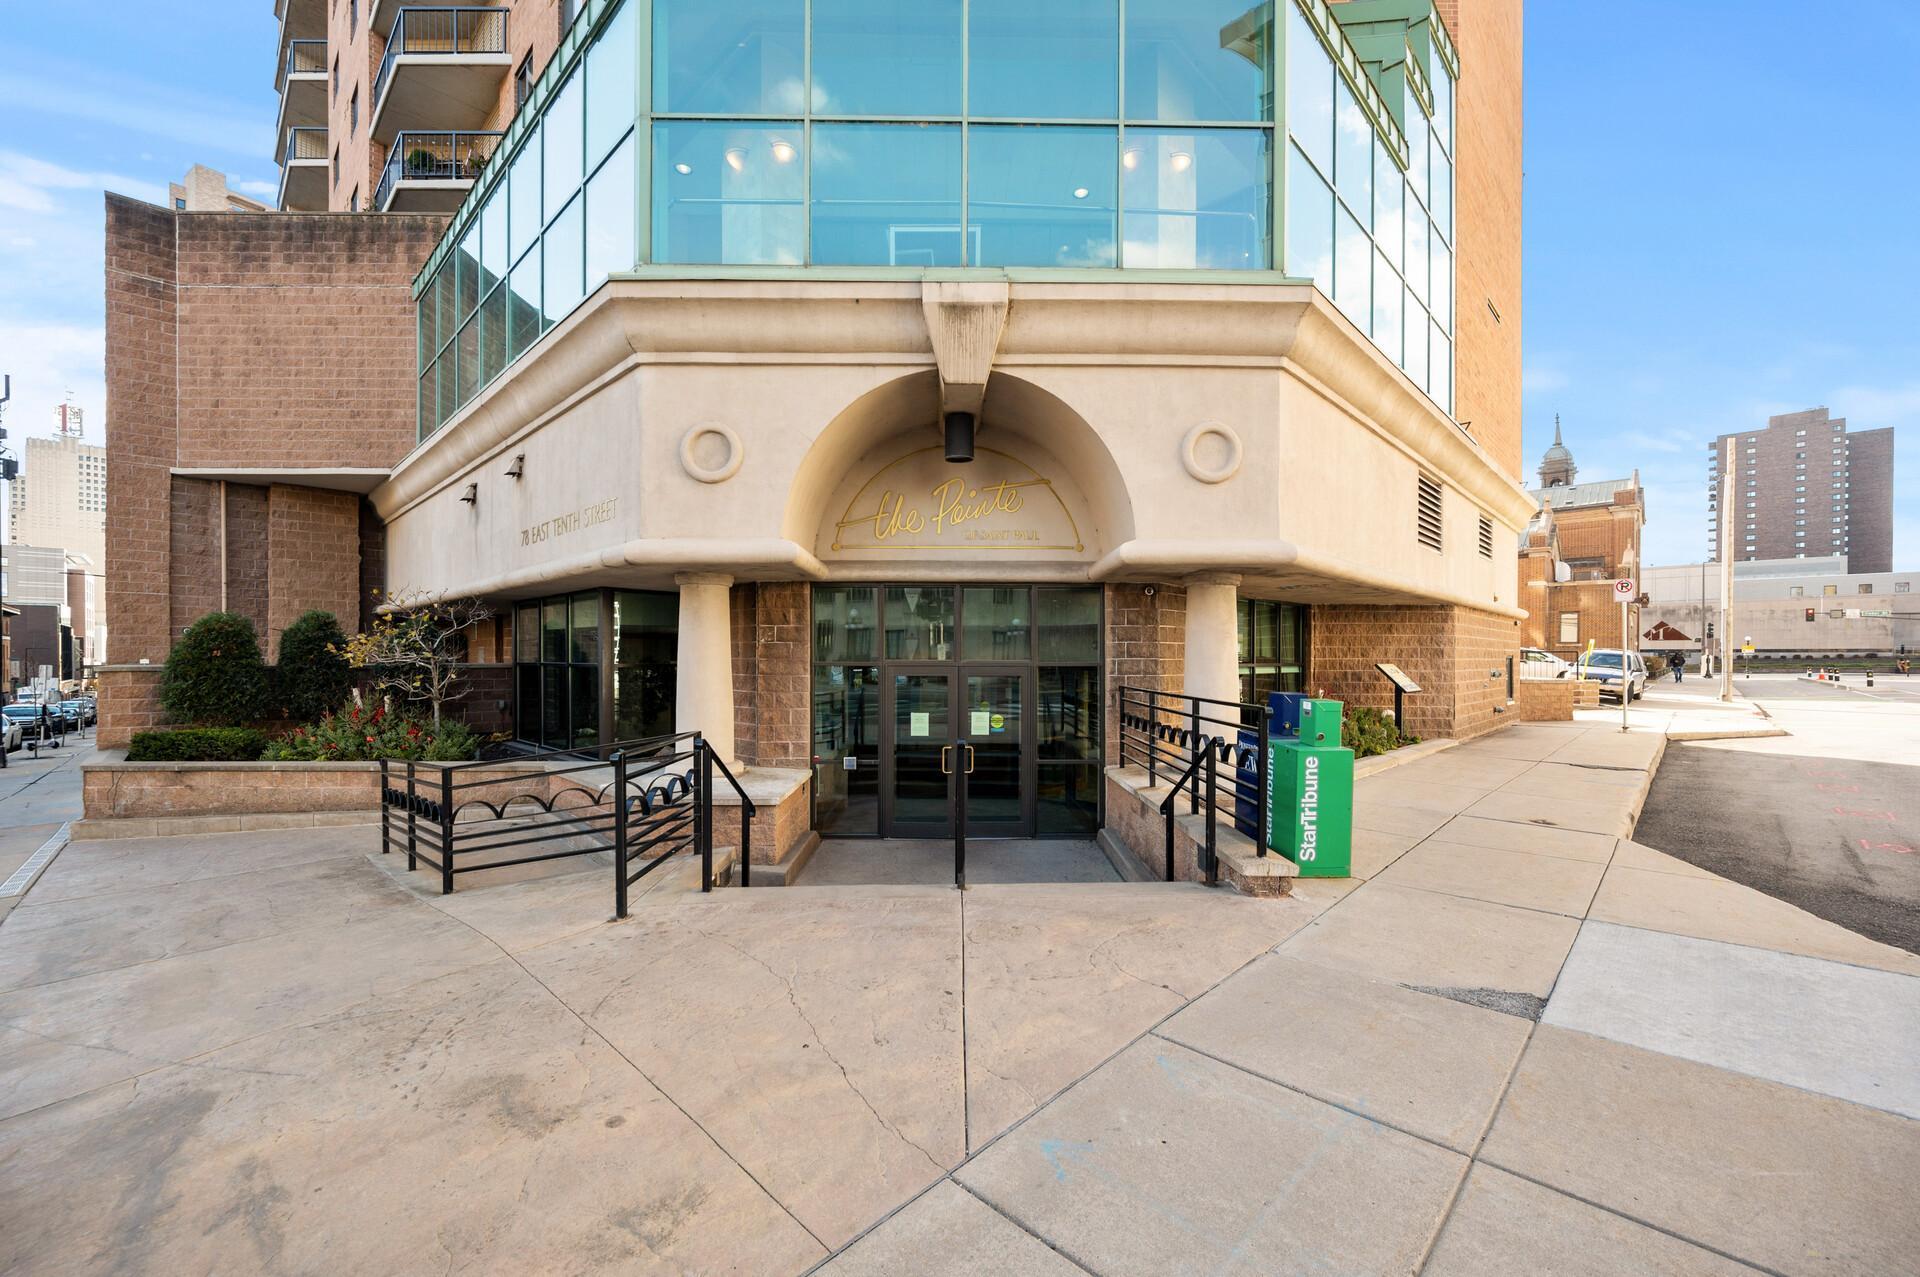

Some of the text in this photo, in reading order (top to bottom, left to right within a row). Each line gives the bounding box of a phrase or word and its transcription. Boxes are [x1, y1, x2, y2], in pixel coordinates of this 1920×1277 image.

[521, 498, 618, 547] 78 EAST TENTH STREET
[870, 477, 1025, 540] the Pointe
[1299, 756, 1319, 862] StarTribune
